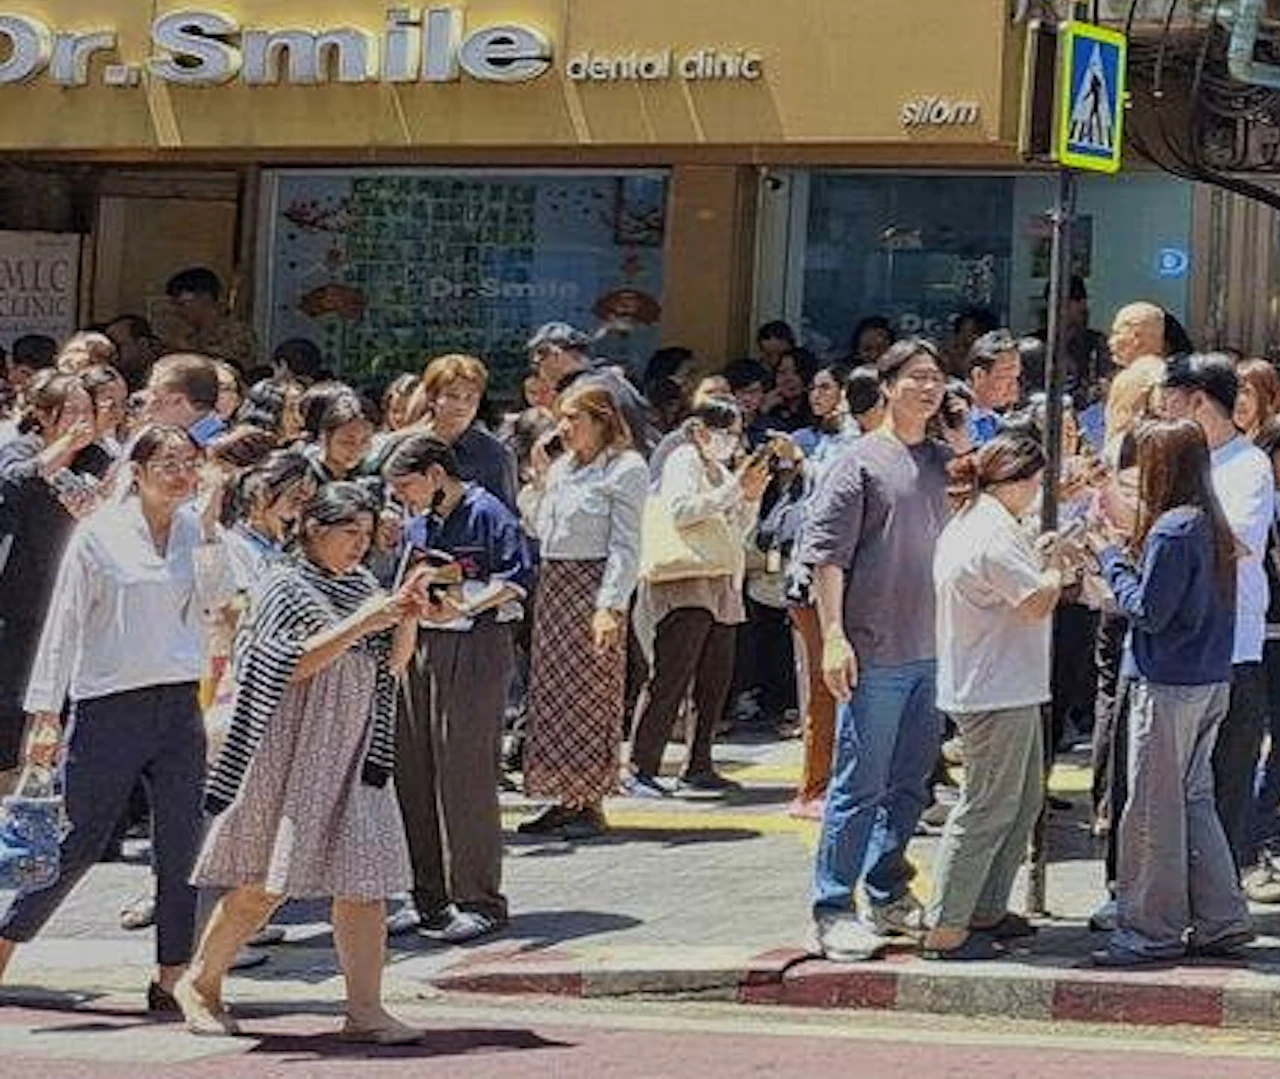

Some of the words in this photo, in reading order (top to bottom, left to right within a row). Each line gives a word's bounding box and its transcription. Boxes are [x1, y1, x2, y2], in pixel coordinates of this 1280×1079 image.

[566, 50, 671, 82] dental
[680, 48, 764, 80] clinic
[901, 97, 979, 126] silom
[0, 259, 69, 293] MLC
